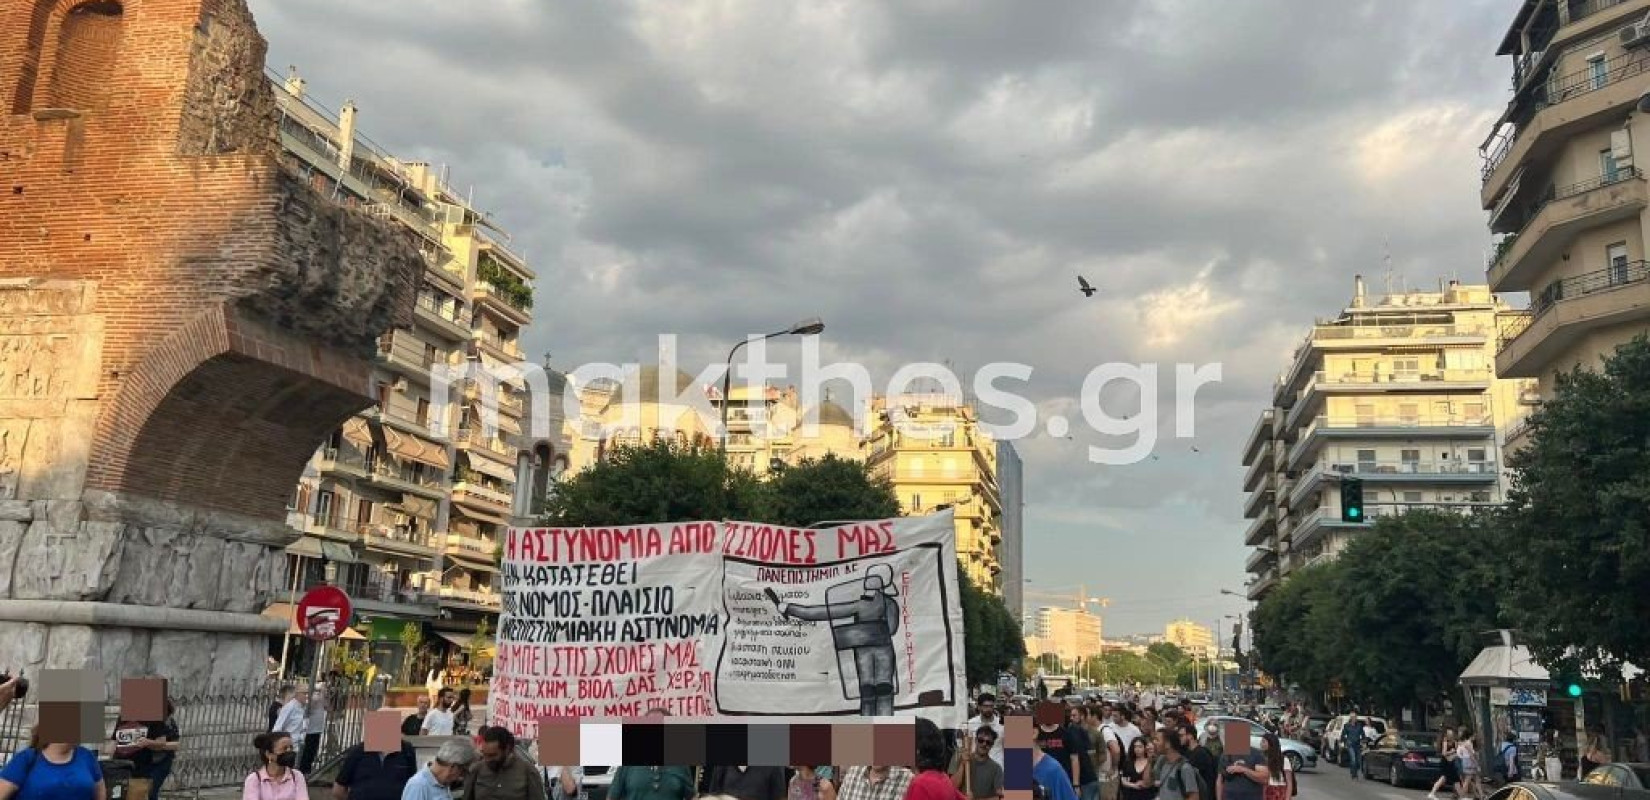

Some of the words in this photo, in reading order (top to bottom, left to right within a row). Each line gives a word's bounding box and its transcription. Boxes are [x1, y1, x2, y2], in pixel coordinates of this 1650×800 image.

[507, 529, 517, 561] Η
[521, 527, 661, 563] ΑΣΤΥΝΟΜΙΑ
[669, 523, 716, 555] ΑΠΟ
[736, 524, 817, 564] ΣΧΟΛΕΣ
[838, 522, 897, 559] ΜΑΣ
[523, 562, 638, 587] ΚΑΤΑΤΕΘΕΙ
[520, 585, 674, 619] ΝΟΜΟΣ-ΠΛΑΙΣΙΟ
[511, 645, 549, 676] ΜΠΕΙ
[552, 646, 588, 677] ΣΤΙΣ
[592, 644, 656, 677] ΣΧΟΛΕΣ
[663, 638, 700, 671] ΜΑΣ
